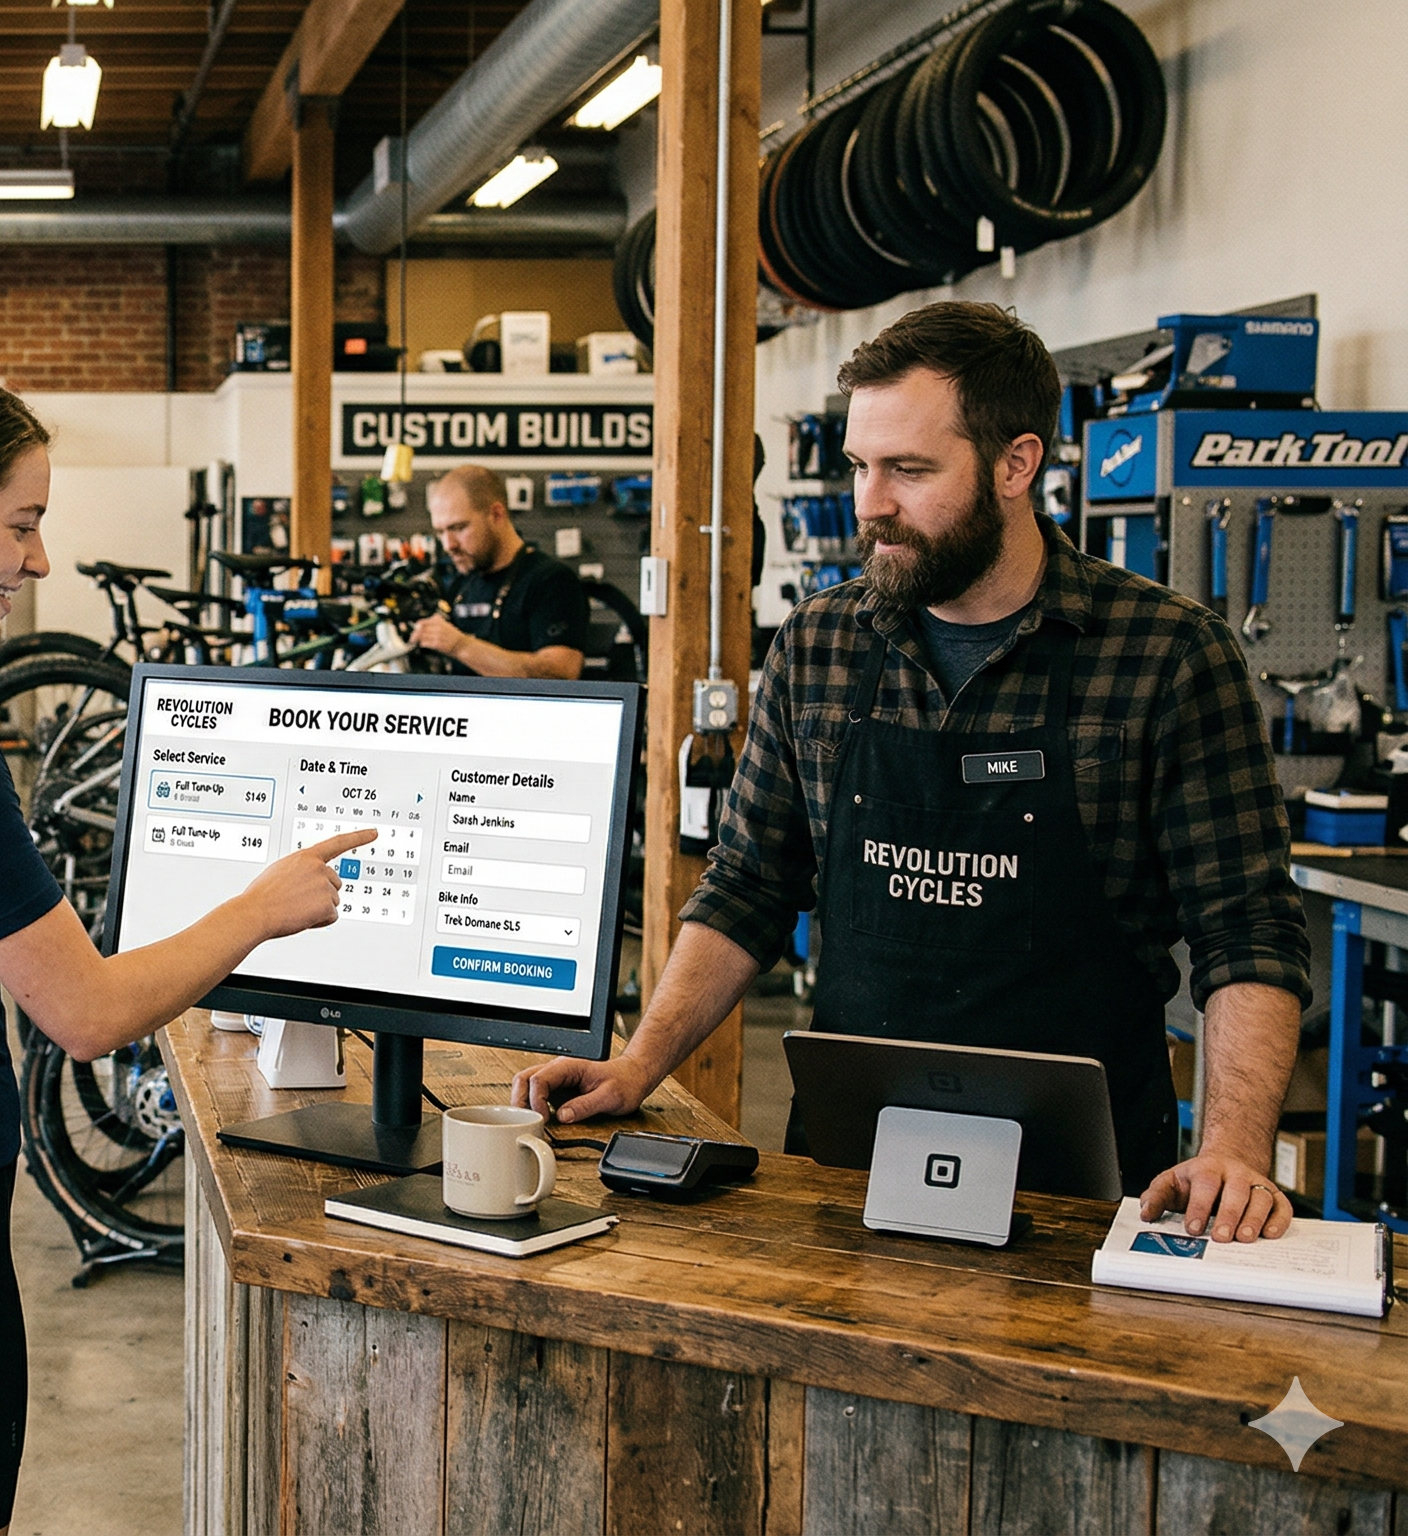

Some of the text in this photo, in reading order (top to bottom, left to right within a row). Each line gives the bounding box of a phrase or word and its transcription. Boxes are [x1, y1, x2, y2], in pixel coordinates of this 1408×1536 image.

[1245, 321, 1314, 337] SHIMANO
[352, 411, 652, 448] CUSTOM BUILDS
[1192, 432, 1306, 467] Park
[157, 698, 233, 715] REVOLUTION
[170, 714, 217, 729] CYCLES
[269, 708, 468, 738] BOOK YOUR SERVICE
[153, 749, 226, 765] Select Service
[300, 759, 368, 775] Date & Time
[987, 760, 1018, 774] MIKE
[175, 781, 189, 790] Full
[451, 769, 554, 788] Customer Details
[245, 791, 266, 802] $149
[342, 787, 377, 800] OCT 26
[449, 792, 476, 803] Name
[481, 816, 515, 828] Jenkins
[391, 829, 396, 837] 3
[444, 841, 469, 853] Email
[863, 839, 1018, 879] REVOLUTION
[366, 867, 375, 875] 16
[448, 864, 473, 876] Email
[345, 884, 354, 893] 22
[364, 886, 372, 895] 23
[382, 888, 391, 896] 24
[889, 873, 983, 907] CYCLES
[438, 892, 478, 905] Bike Info
[342, 904, 352, 913] 29
[444, 914, 463, 926] Trek
[465, 916, 501, 930] Domane
[452, 957, 553, 979] CONFIRM BOOKING
